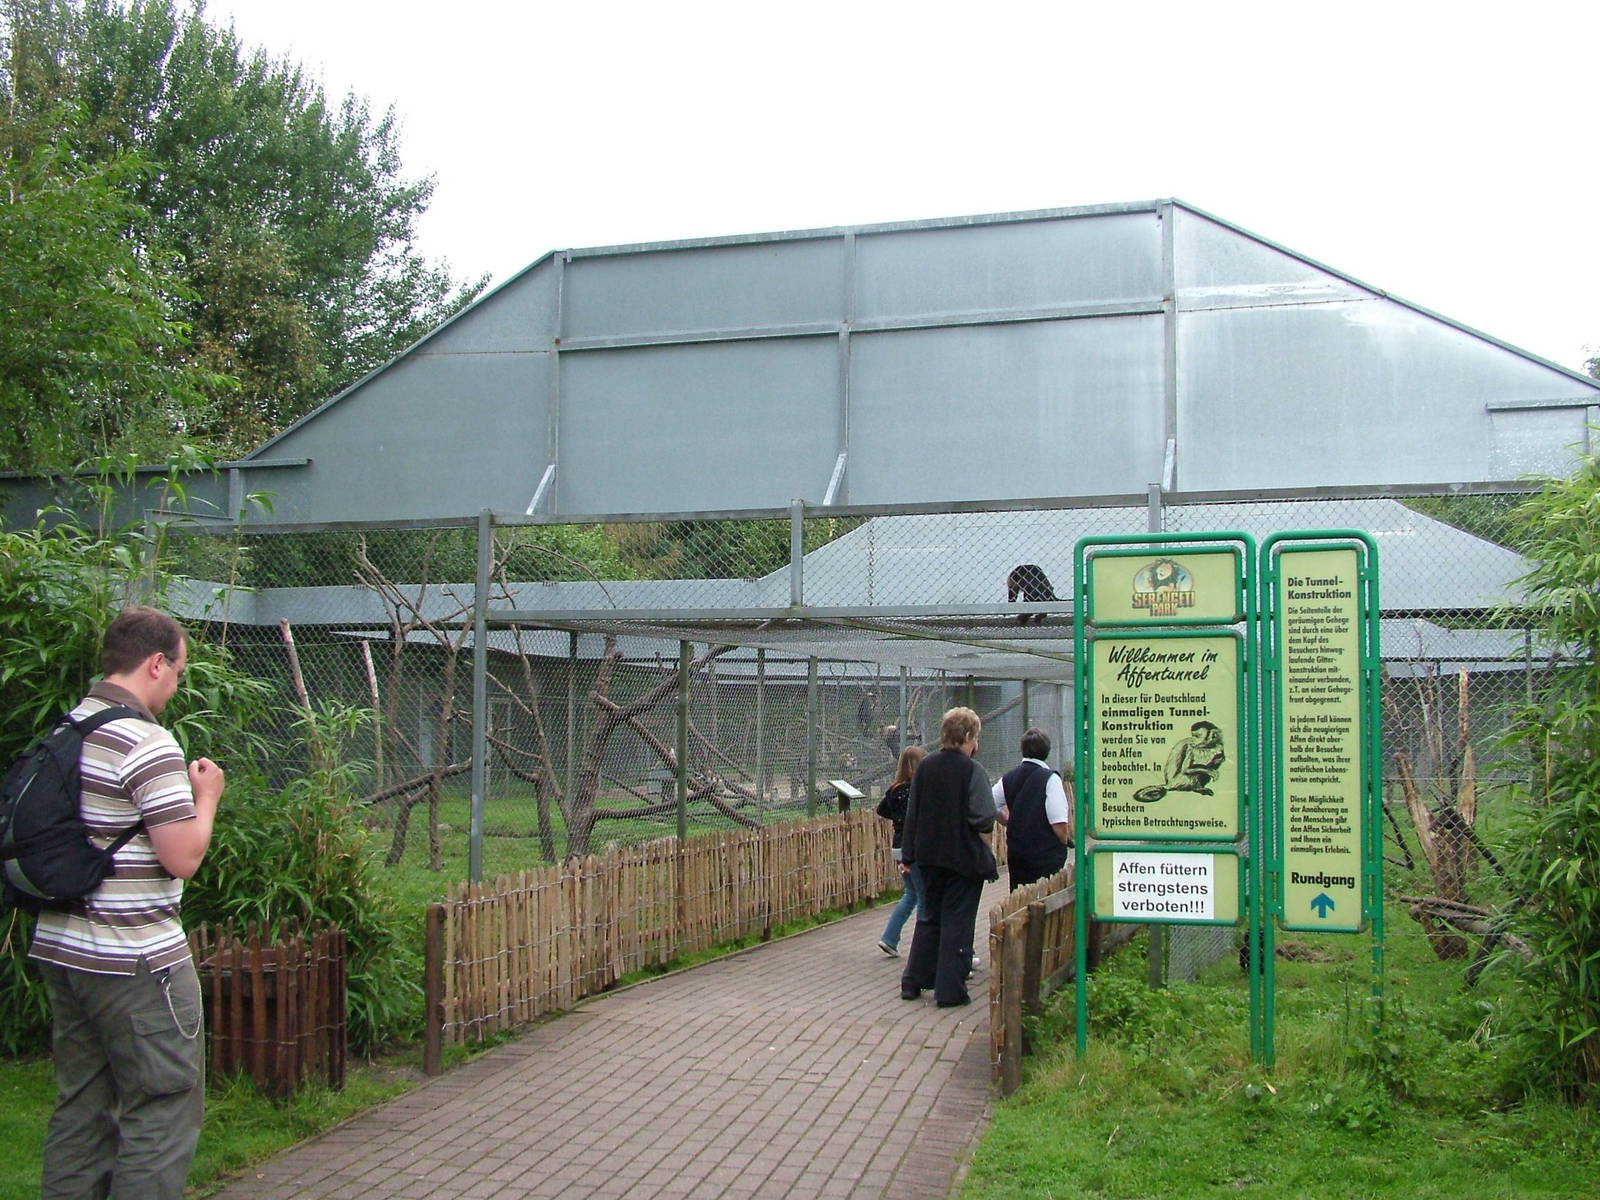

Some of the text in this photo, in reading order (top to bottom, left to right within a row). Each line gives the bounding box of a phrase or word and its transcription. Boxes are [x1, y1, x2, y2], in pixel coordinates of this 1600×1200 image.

[1288, 576, 1343, 586] Die Tunnel-
[1288, 589, 1351, 599] Konstruktion
[1132, 592, 1195, 608] SERENGETI
[1150, 603, 1178, 616] PARK
[1326, 616, 1349, 624] Gehege
[1303, 636, 1317, 644] Kopf
[1109, 646, 1218, 663] Willkommen im
[1117, 663, 1210, 688] Affentunnel
[1101, 694, 1206, 704] In dieser für Deutschland
[1102, 708, 1210, 719] einmaligen Tunnel-
[1102, 721, 1173, 730] Konstruktion
[1297, 716, 1315, 725] jedem
[1102, 735, 1133, 744] werden
[1136, 735, 1148, 744] Sie
[1102, 749, 1142, 757] den Affen
[1102, 762, 1161, 771] beobachtet. In
[1102, 776, 1115, 785] der
[1102, 789, 1117, 798] den
[1309, 796, 1344, 805] Möglichkeit
[1102, 803, 1144, 812] Besuchern
[1102, 816, 1227, 830] typischen Betrachtungsweise.
[1335, 816, 1347, 825] gibt
[1291, 845, 1323, 855] einmaliges
[1118, 863, 1207, 876] Affen füttern
[1291, 872, 1355, 888] Rundgang
[1118, 881, 1208, 896] strengstens
[1122, 900, 1204, 913] verboten!!!
